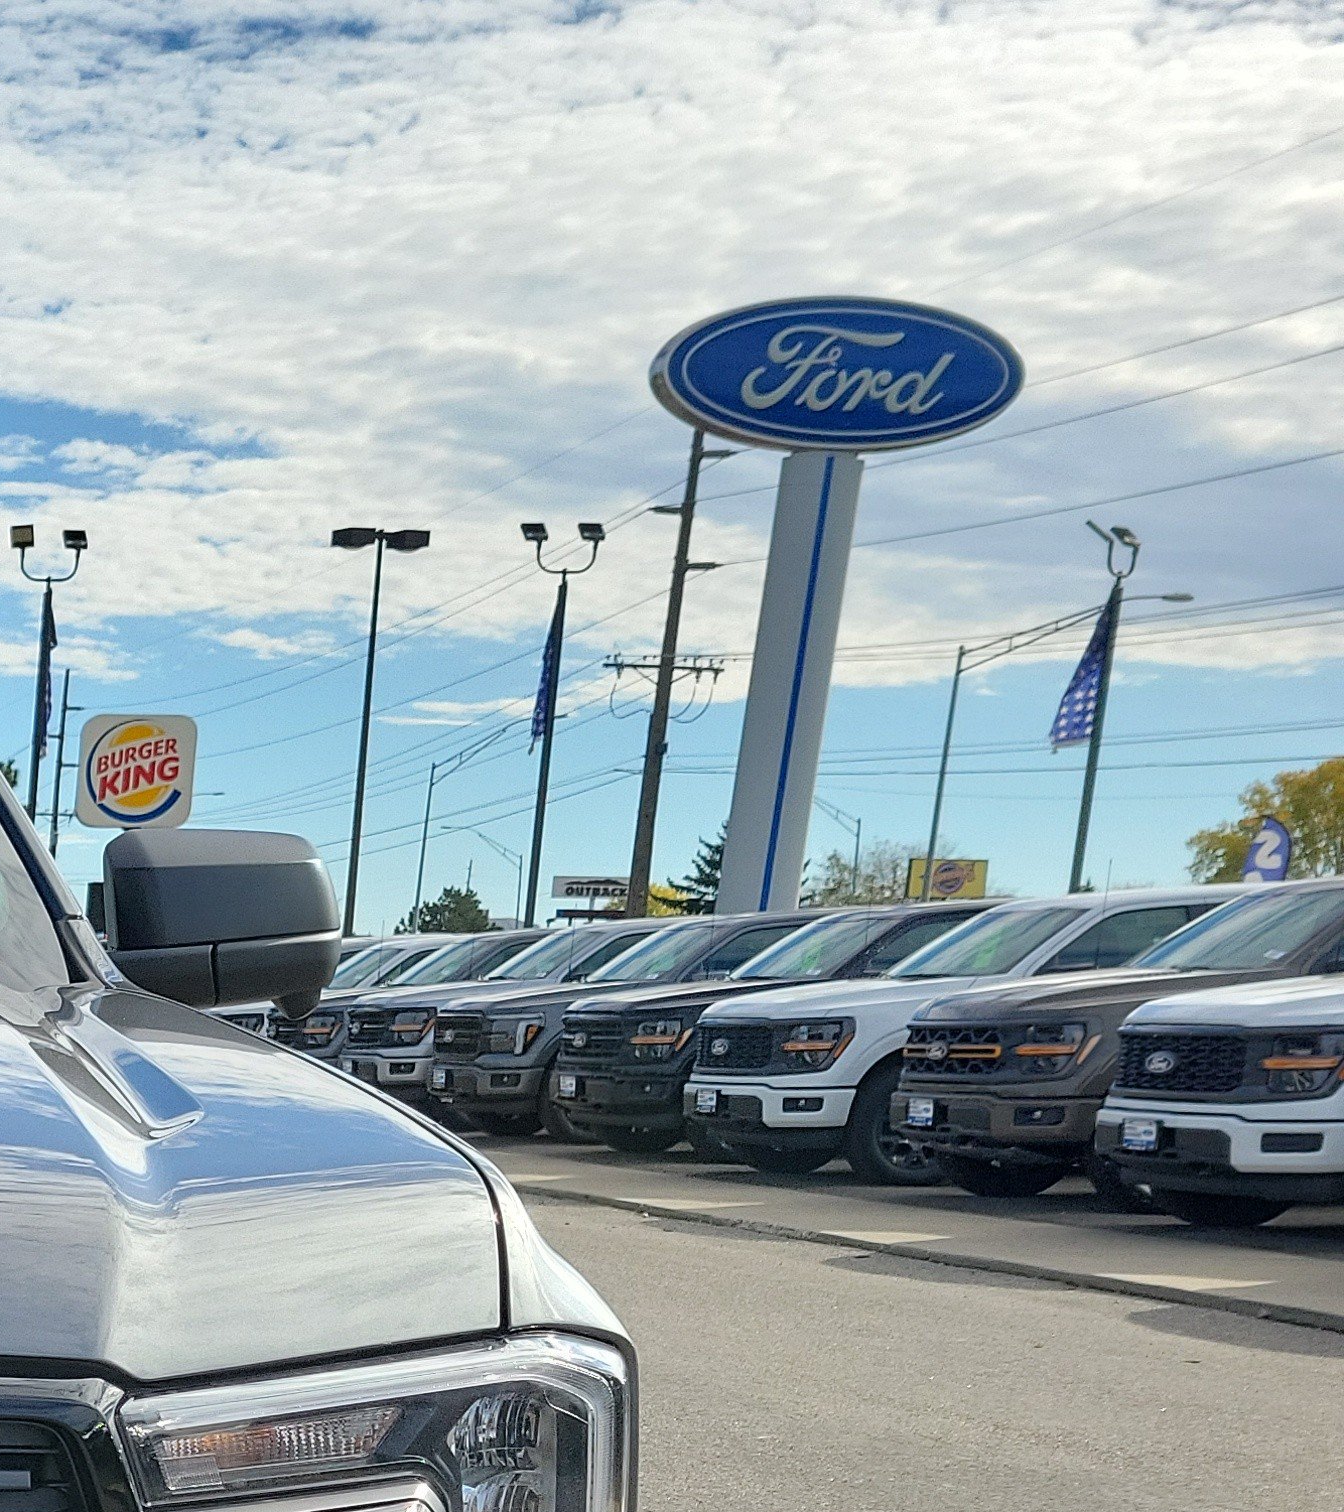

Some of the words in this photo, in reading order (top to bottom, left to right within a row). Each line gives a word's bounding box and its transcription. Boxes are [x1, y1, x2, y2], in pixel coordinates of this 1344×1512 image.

[741, 324, 956, 415] Ford
[96, 738, 178, 775] BURGER
[98, 756, 180, 802] KING
[565, 886, 628, 897] OUTBACK
